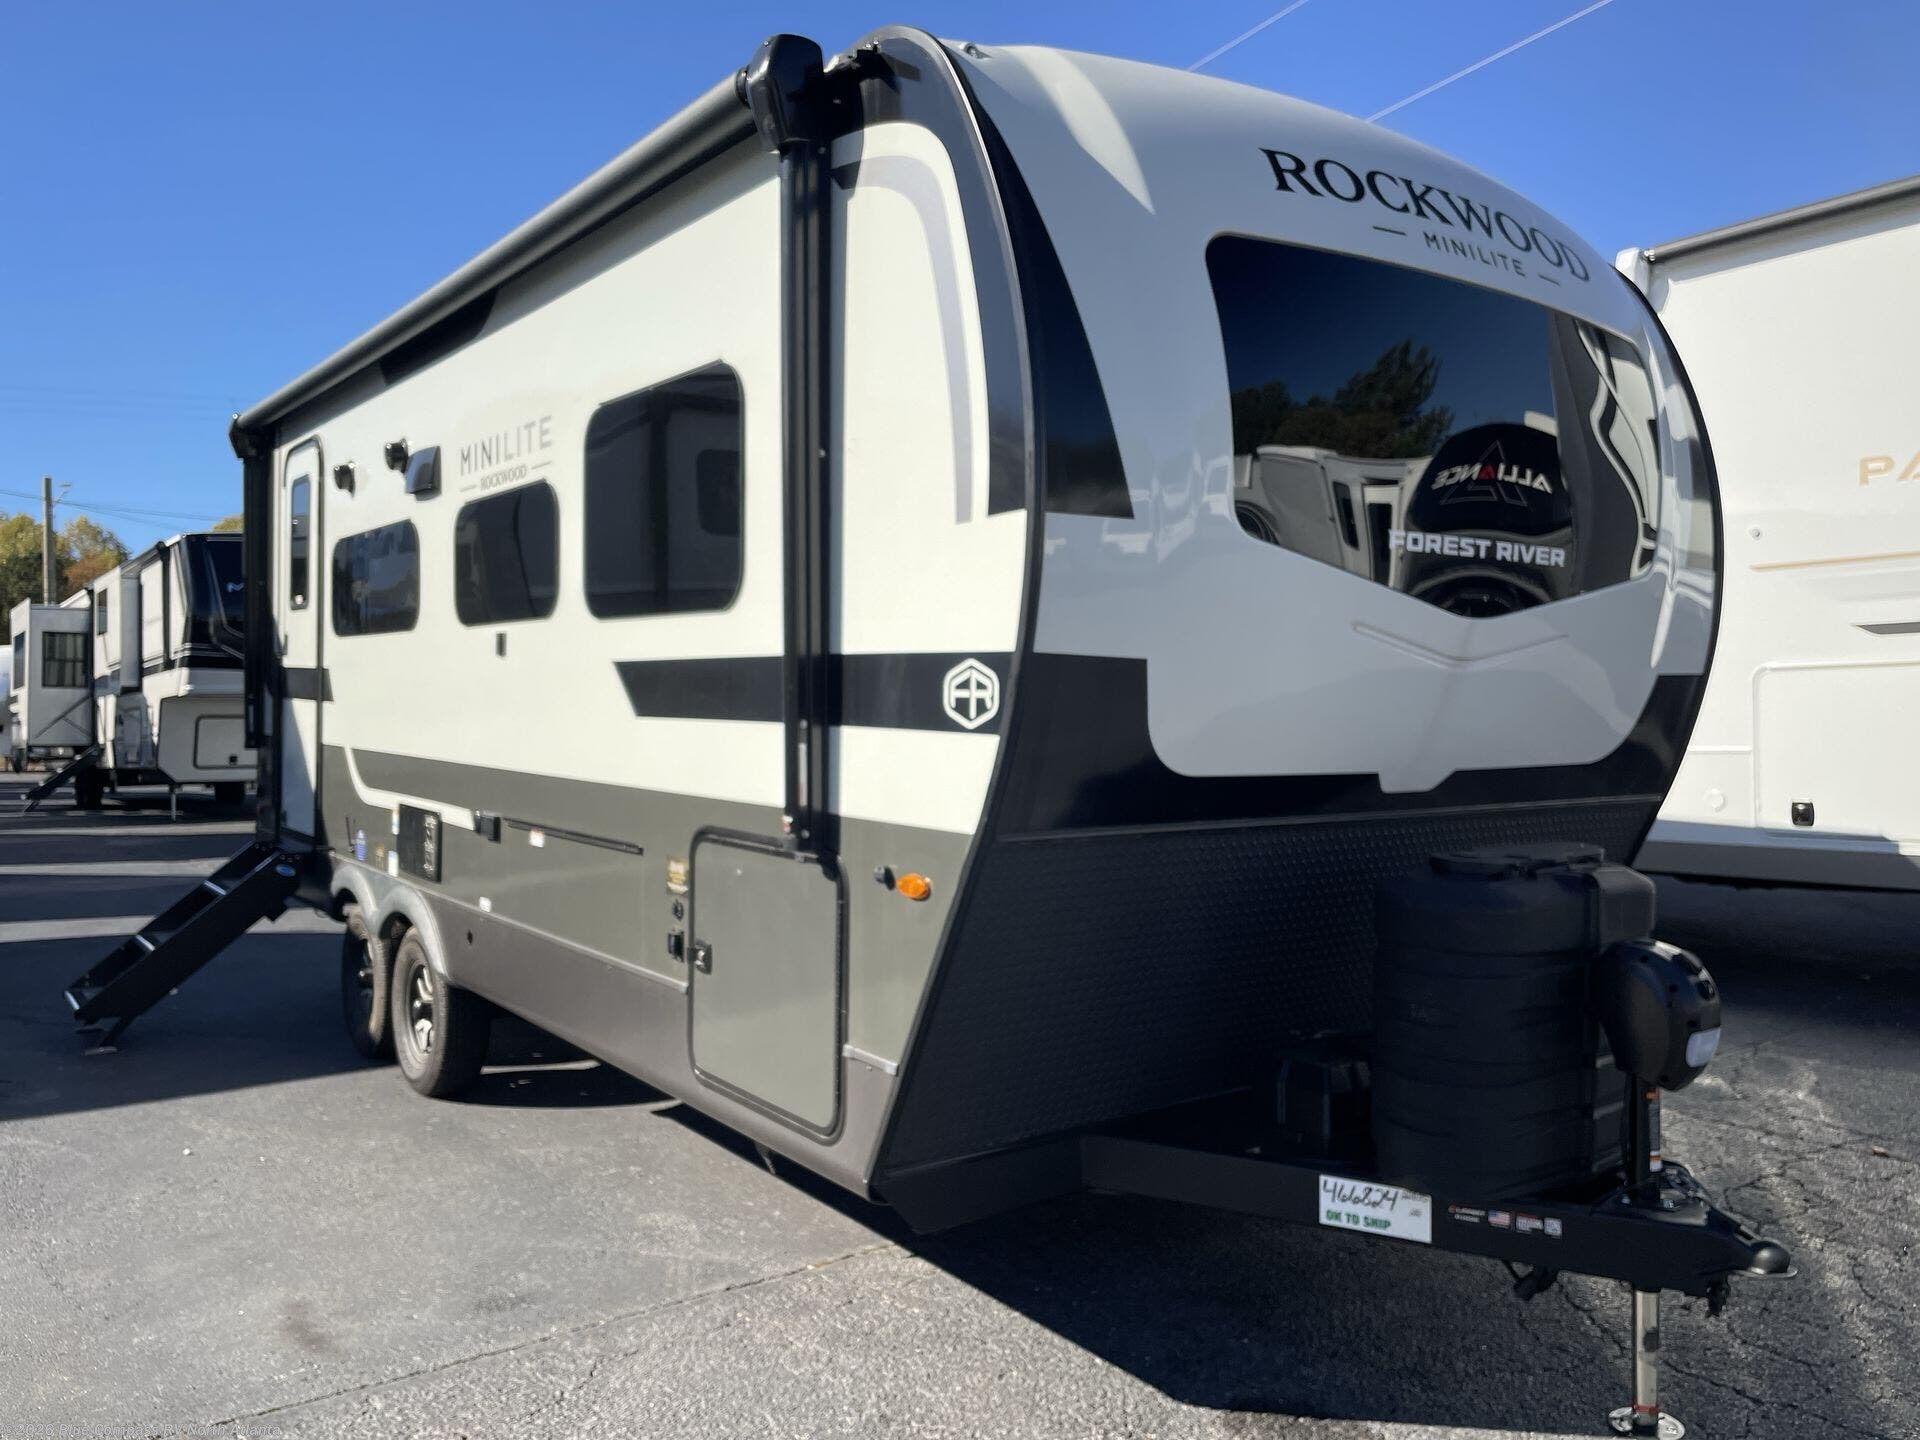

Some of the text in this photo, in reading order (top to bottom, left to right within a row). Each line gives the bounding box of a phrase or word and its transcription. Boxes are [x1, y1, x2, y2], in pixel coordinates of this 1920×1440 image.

[1258, 148, 1591, 282] ROCKWOOD
[1423, 231, 1527, 277] MINILITE
[460, 415, 553, 477] MINILITE
[480, 463, 528, 491] ROCKWOOD
[1388, 529, 1565, 568] FOREST RIVER
[1322, 1179, 1398, 1212] 466824
[1326, 1209, 1392, 1230] OK TO SHIP
